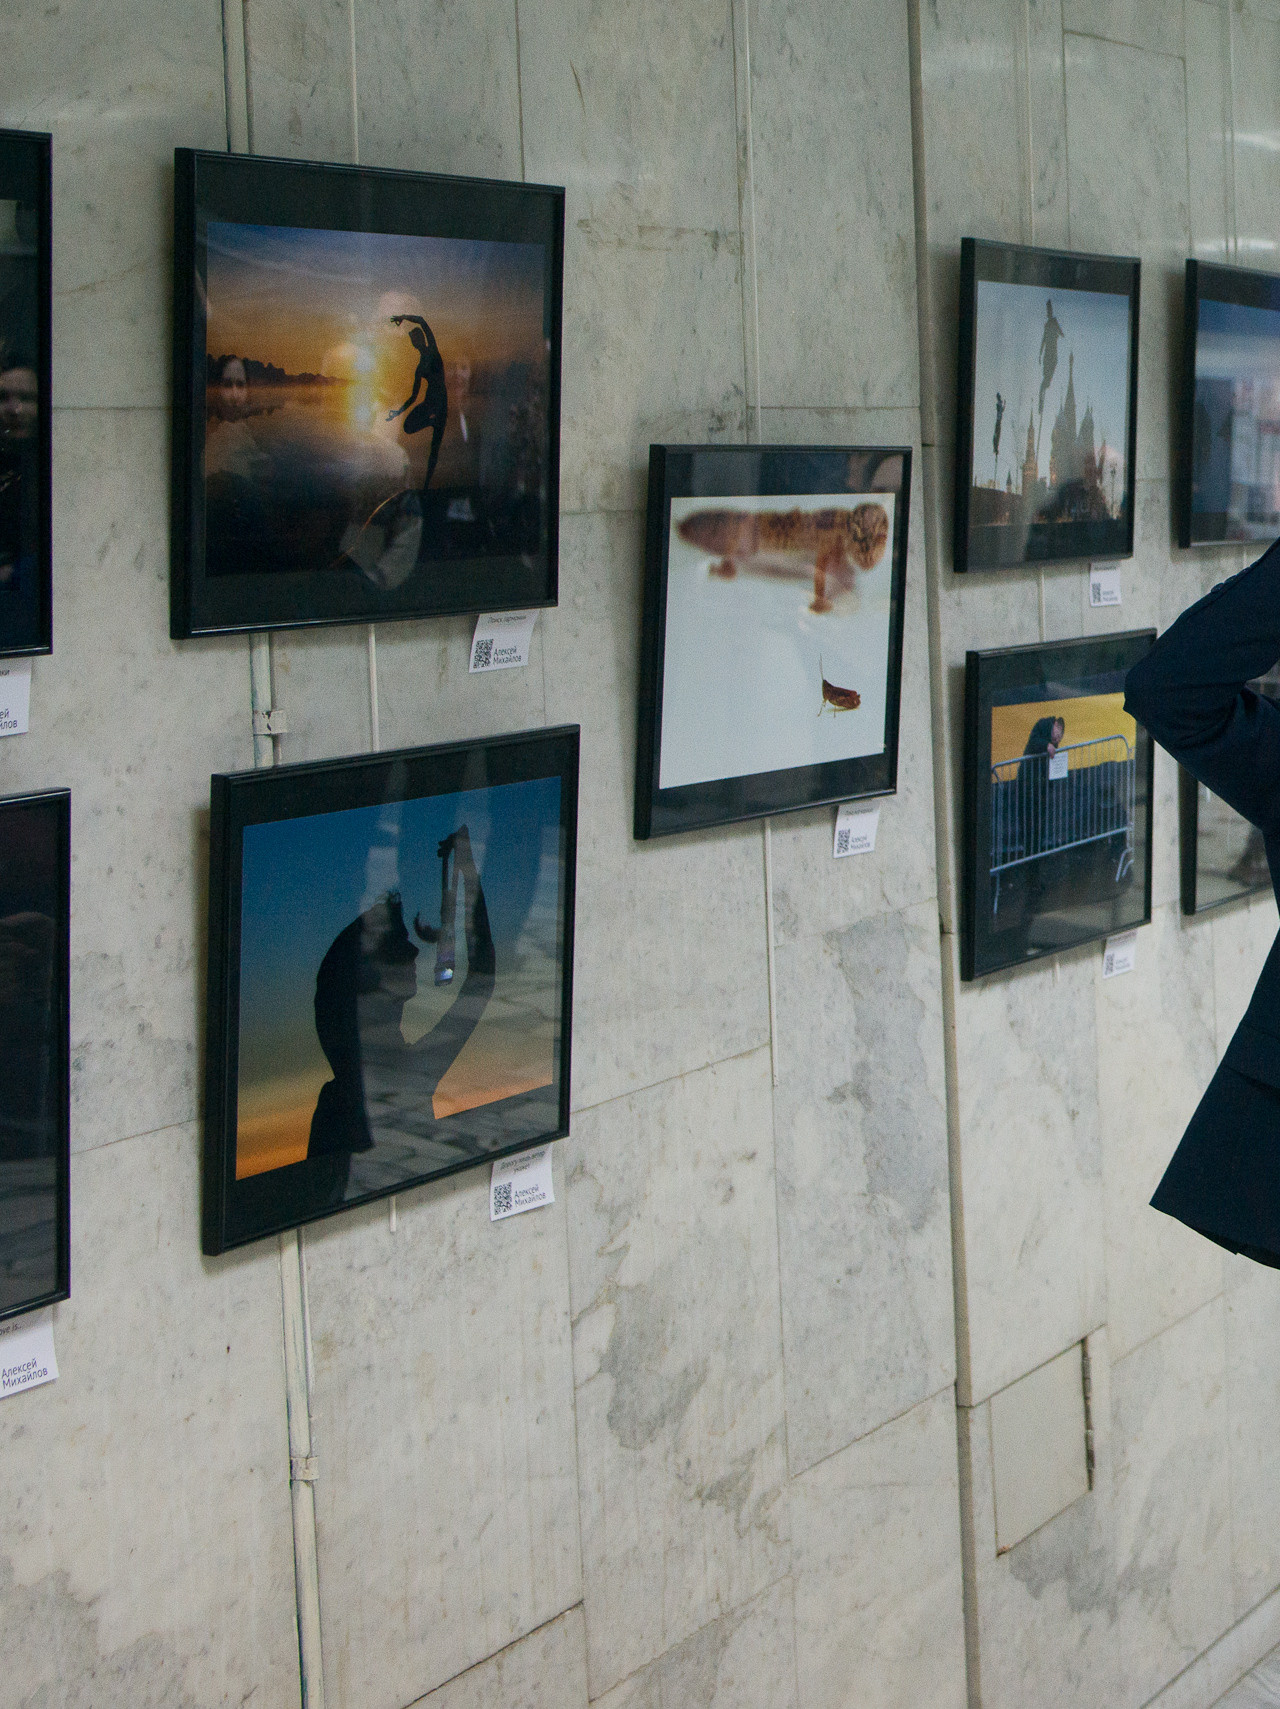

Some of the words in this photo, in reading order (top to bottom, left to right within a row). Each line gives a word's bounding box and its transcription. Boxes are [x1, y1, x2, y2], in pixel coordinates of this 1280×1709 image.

[494, 645, 517, 656] Алексей
[493, 655, 522, 666] Михайлов
[514, 1183, 539, 1198] Алексей
[514, 1192, 546, 1207] Михайлов
[1, 1357, 38, 1379] Алексей
[2, 1367, 48, 1390] Михайлов
